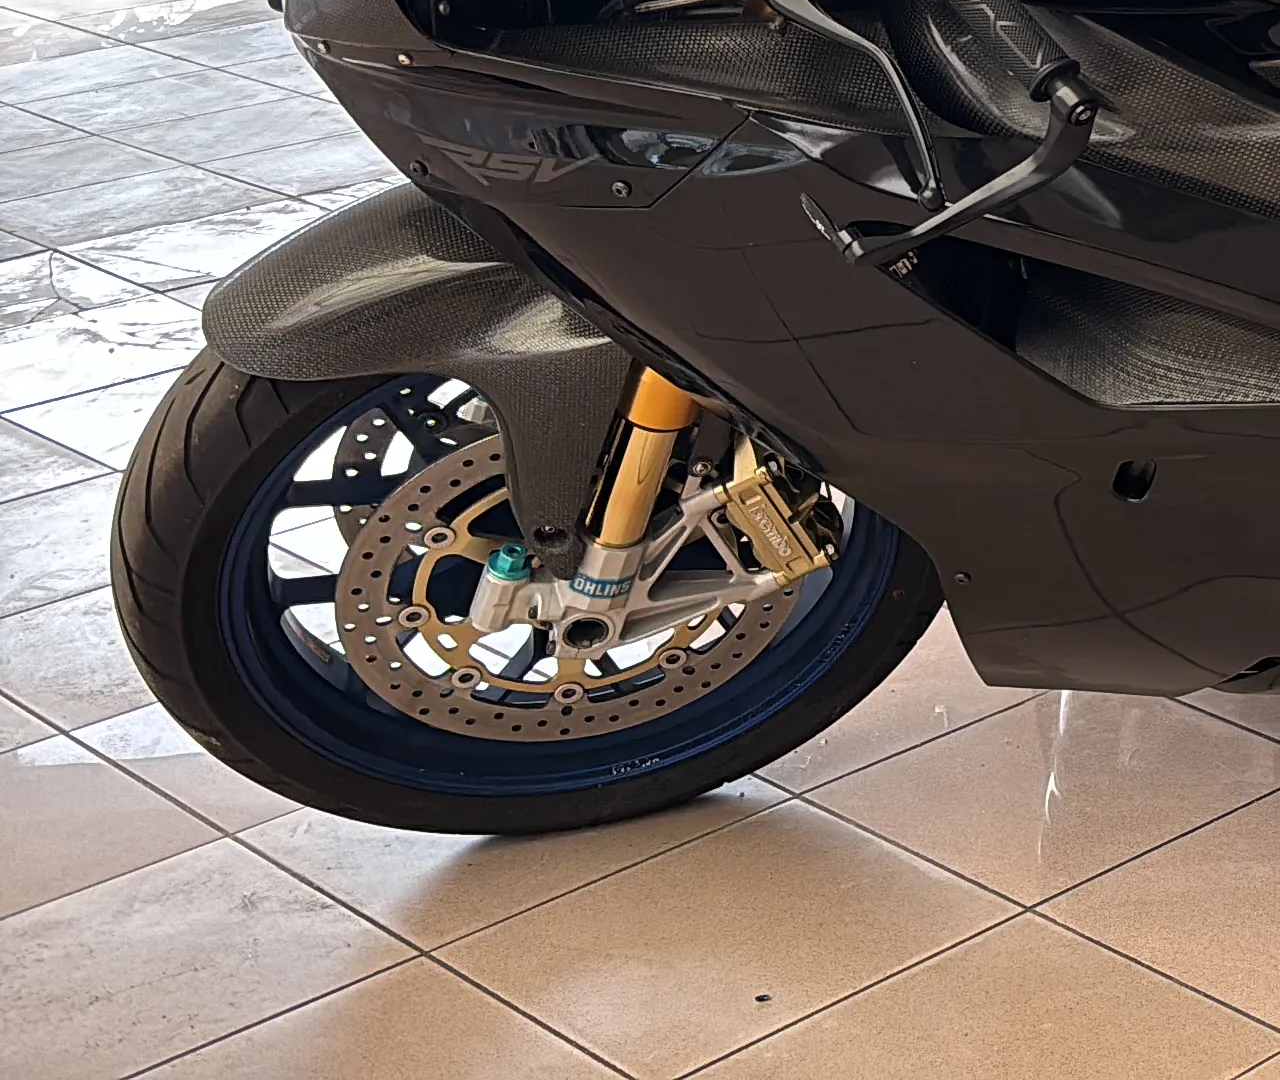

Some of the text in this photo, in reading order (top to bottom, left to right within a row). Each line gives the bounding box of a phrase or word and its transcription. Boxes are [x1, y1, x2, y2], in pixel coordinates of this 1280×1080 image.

[416, 133, 600, 186] RSV
[749, 503, 793, 557] brembo
[573, 573, 632, 597] ÖHLINS
